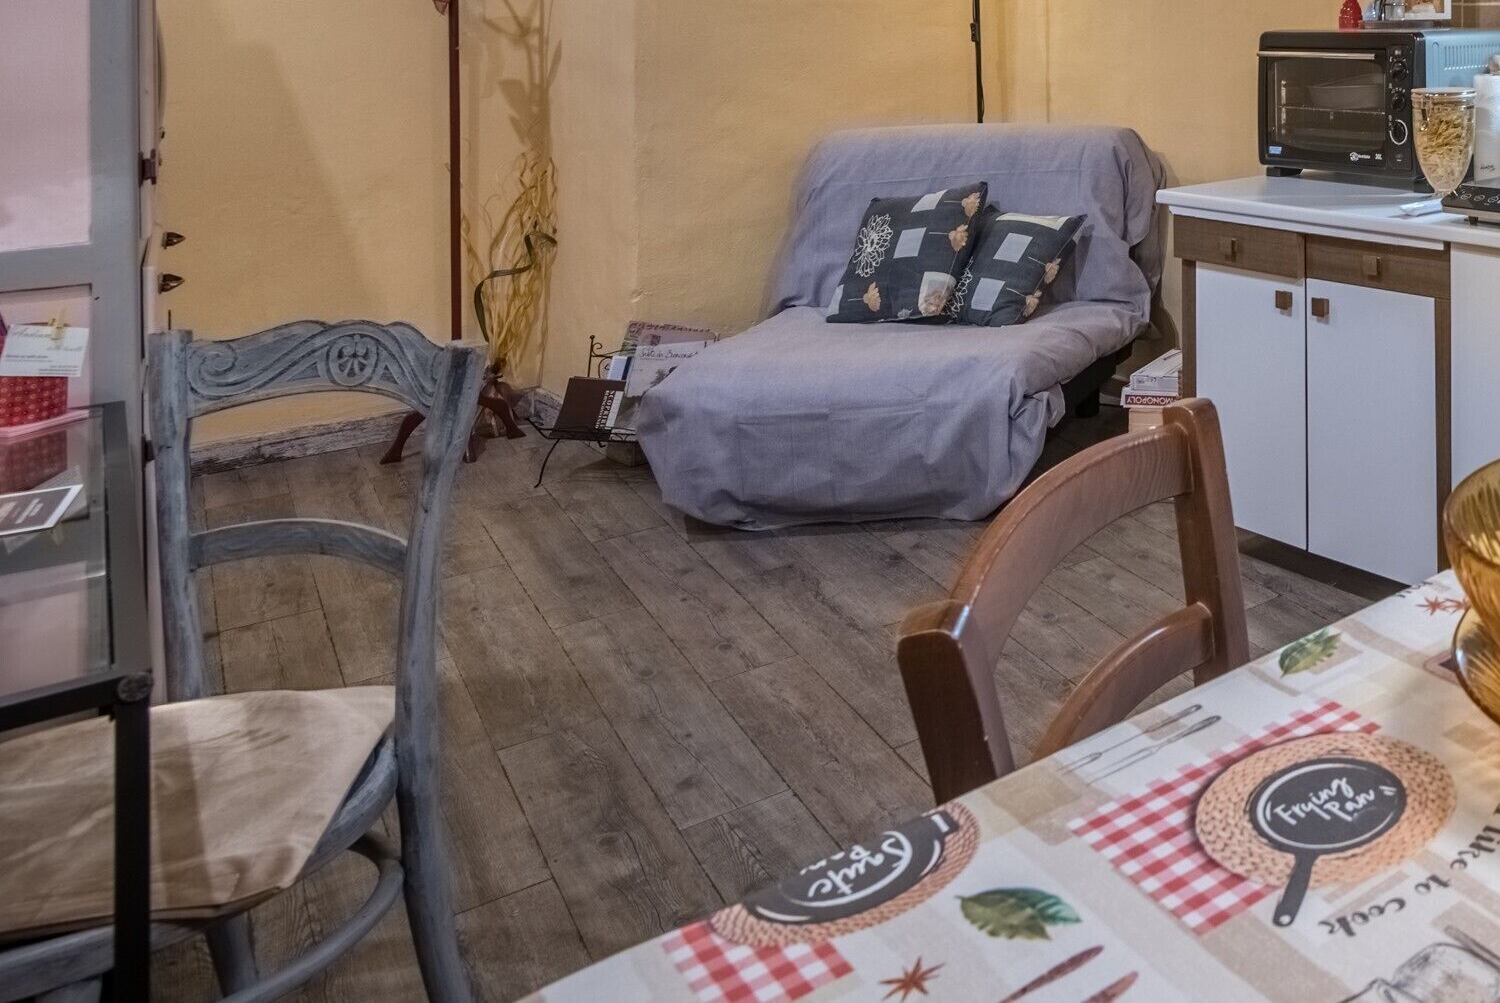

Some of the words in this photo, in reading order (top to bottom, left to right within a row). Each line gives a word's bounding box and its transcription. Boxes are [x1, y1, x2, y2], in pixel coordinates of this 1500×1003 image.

[1273, 776, 1355, 826] Frying
[1324, 788, 1376, 822] Pan
[1414, 873, 1451, 898] to
